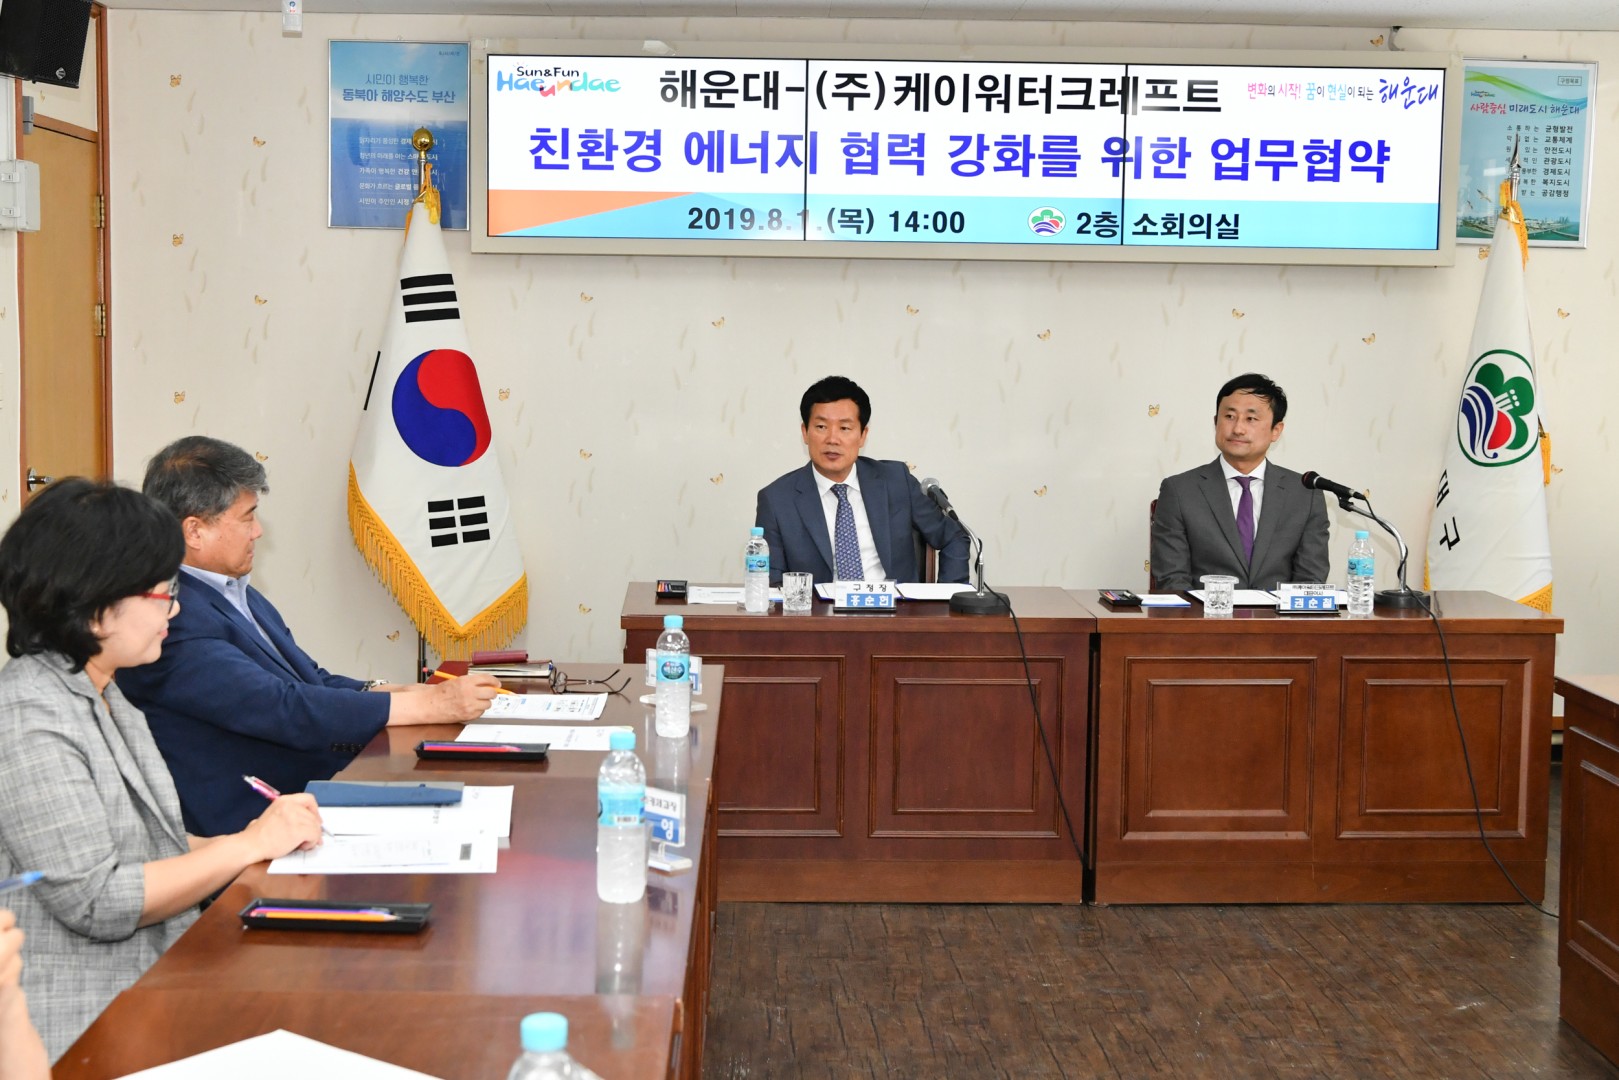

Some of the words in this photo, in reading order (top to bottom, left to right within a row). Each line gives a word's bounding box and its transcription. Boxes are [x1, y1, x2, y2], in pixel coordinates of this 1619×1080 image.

[516, 66, 580, 77] Sun&Fun
[364, 74, 395, 86] 시민이
[398, 74, 429, 86] 행복한
[496, 70, 621, 97] Haeundae
[342, 88, 378, 102] 동북아
[381, 89, 429, 103] 해양수도
[432, 90, 456, 104] 부산
[1247, 82, 1276, 99] 변화의
[1278, 83, 1302, 100] 시작!
[1305, 82, 1325, 100] 꿈이
[1327, 83, 1355, 101] 현실이
[1357, 86, 1374, 101] 되는
[1379, 76, 1438, 109] 해운대
[1470, 102, 1507, 115] 사람중심
[1509, 104, 1547, 115] 미래도시
[1550, 104, 1580, 117] 해운대
[1545, 125, 1573, 133] 균형발전
[1544, 136, 1572, 144] 교통체계
[529, 128, 662, 173] 친환경
[684, 129, 819, 175] 에너지
[840, 130, 927, 177] 협력
[947, 133, 1082, 178] 강화를
[1101, 136, 1192, 180] 위한
[1211, 137, 1392, 184] 업무협약
[1544, 146, 1572, 155] 안전도시
[1543, 157, 1571, 166] 관광도시
[1543, 168, 1571, 176] 경제도시
[1542, 179, 1570, 187] 복지도시
[1541, 189, 1569, 198] 공감행정
[688, 207, 875, 235] 2019.8.1.(목)
[888, 210, 966, 234] 14:00
[1076, 211, 1120, 239] 2층
[1131, 212, 1240, 240] 소회의실
